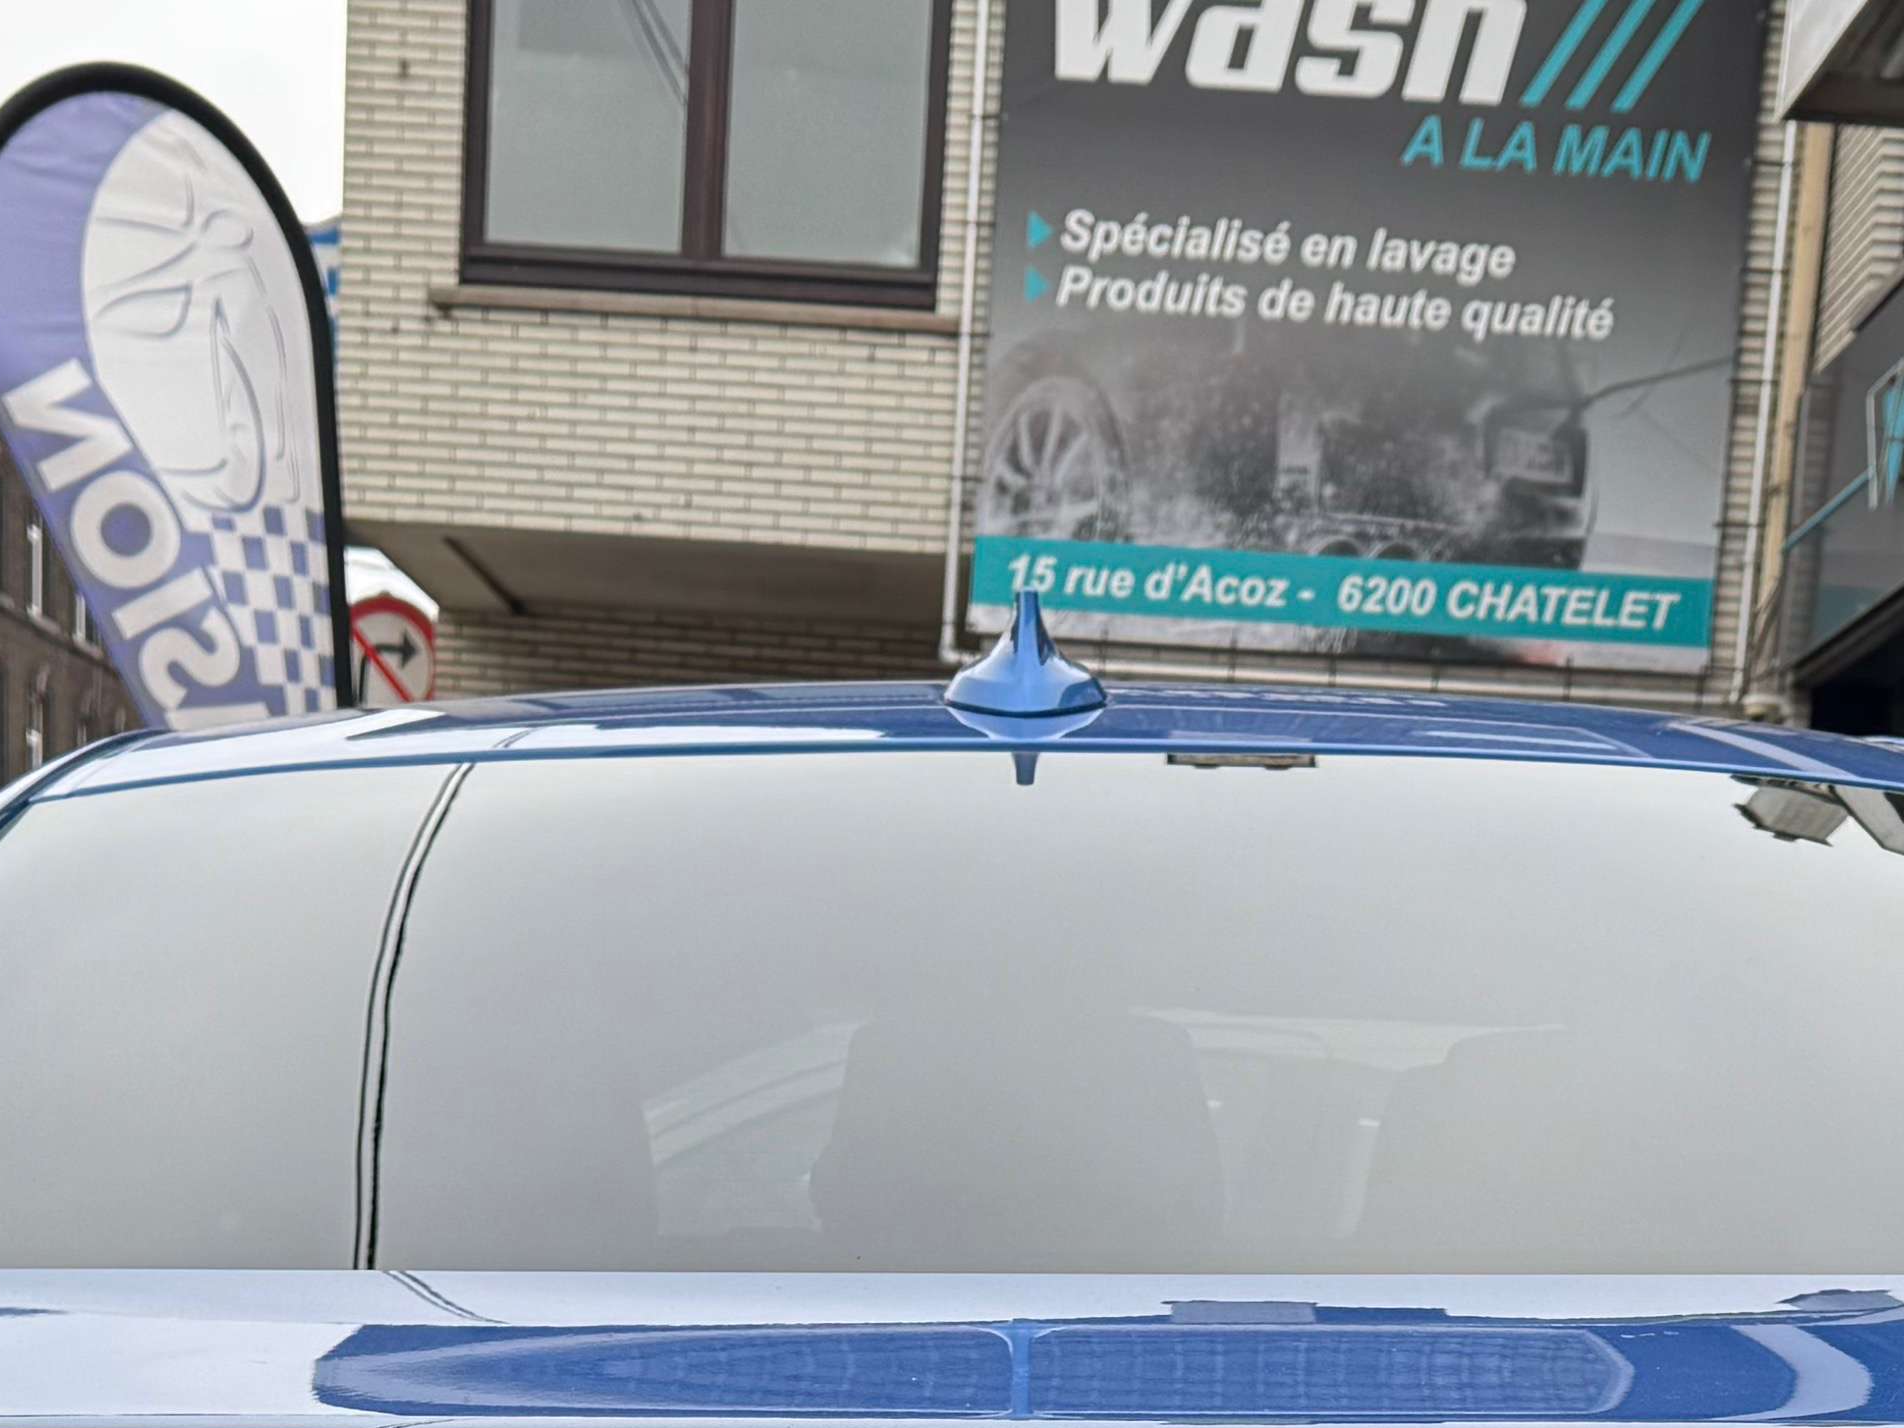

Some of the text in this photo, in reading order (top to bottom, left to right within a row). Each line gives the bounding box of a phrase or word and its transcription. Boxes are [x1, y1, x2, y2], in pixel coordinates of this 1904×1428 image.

[1401, 115, 1712, 182] A LA MAIN
[1060, 208, 1516, 286] Spécialisé en lavage
[1056, 264, 1614, 342] Produits de haute qualité
[1008, 553, 1056, 594] 15
[1064, 565, 1134, 598] rue
[1144, 563, 1289, 607] d'Acoz
[1336, 574, 1437, 618] 6200
[1446, 579, 1681, 631] CHATELET
